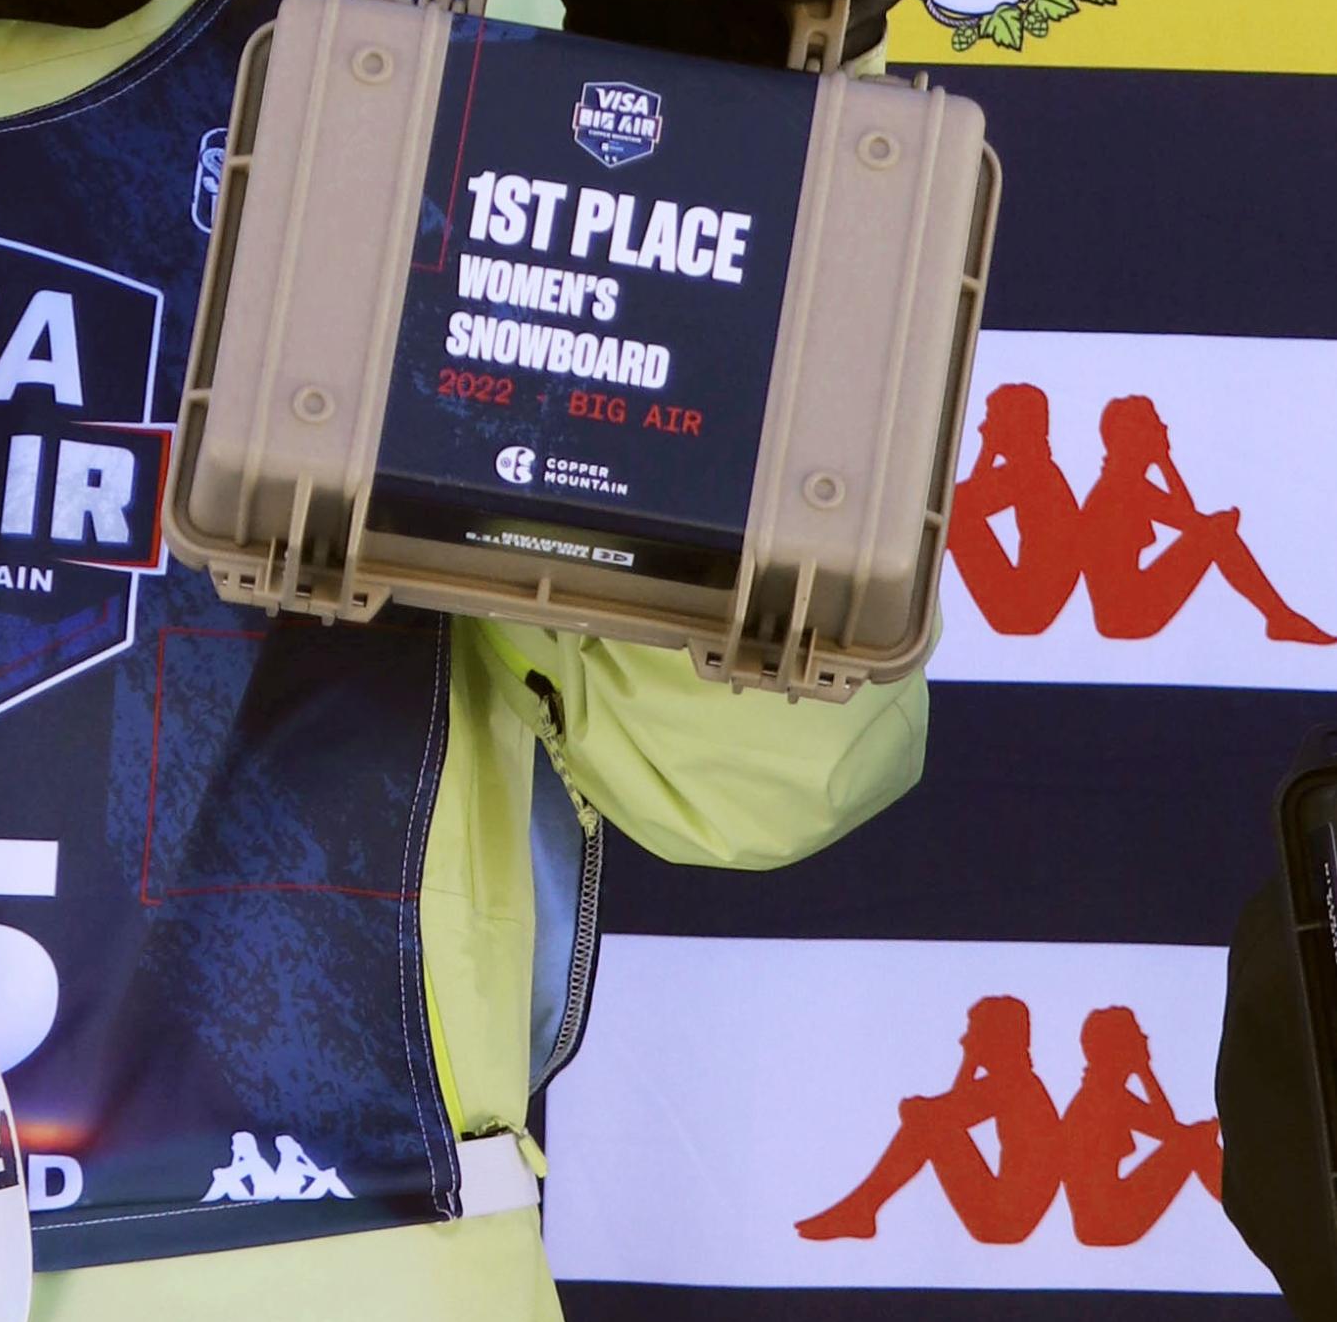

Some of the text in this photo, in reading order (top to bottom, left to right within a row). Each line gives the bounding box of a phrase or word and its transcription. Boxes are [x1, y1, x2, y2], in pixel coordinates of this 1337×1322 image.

[579, 108, 616, 131] BIG
[617, 114, 656, 137] AIR
[595, 87, 648, 117] VISA
[467, 170, 752, 284] 1ST PLACE
[458, 253, 619, 322] WOMEN'S
[445, 311, 670, 389] SNOWBOARD
[437, 368, 703, 437] 2022 BIG AIR
[544, 471, 628, 495] MOUNTAIN
[546, 457, 609, 478] COPPER
